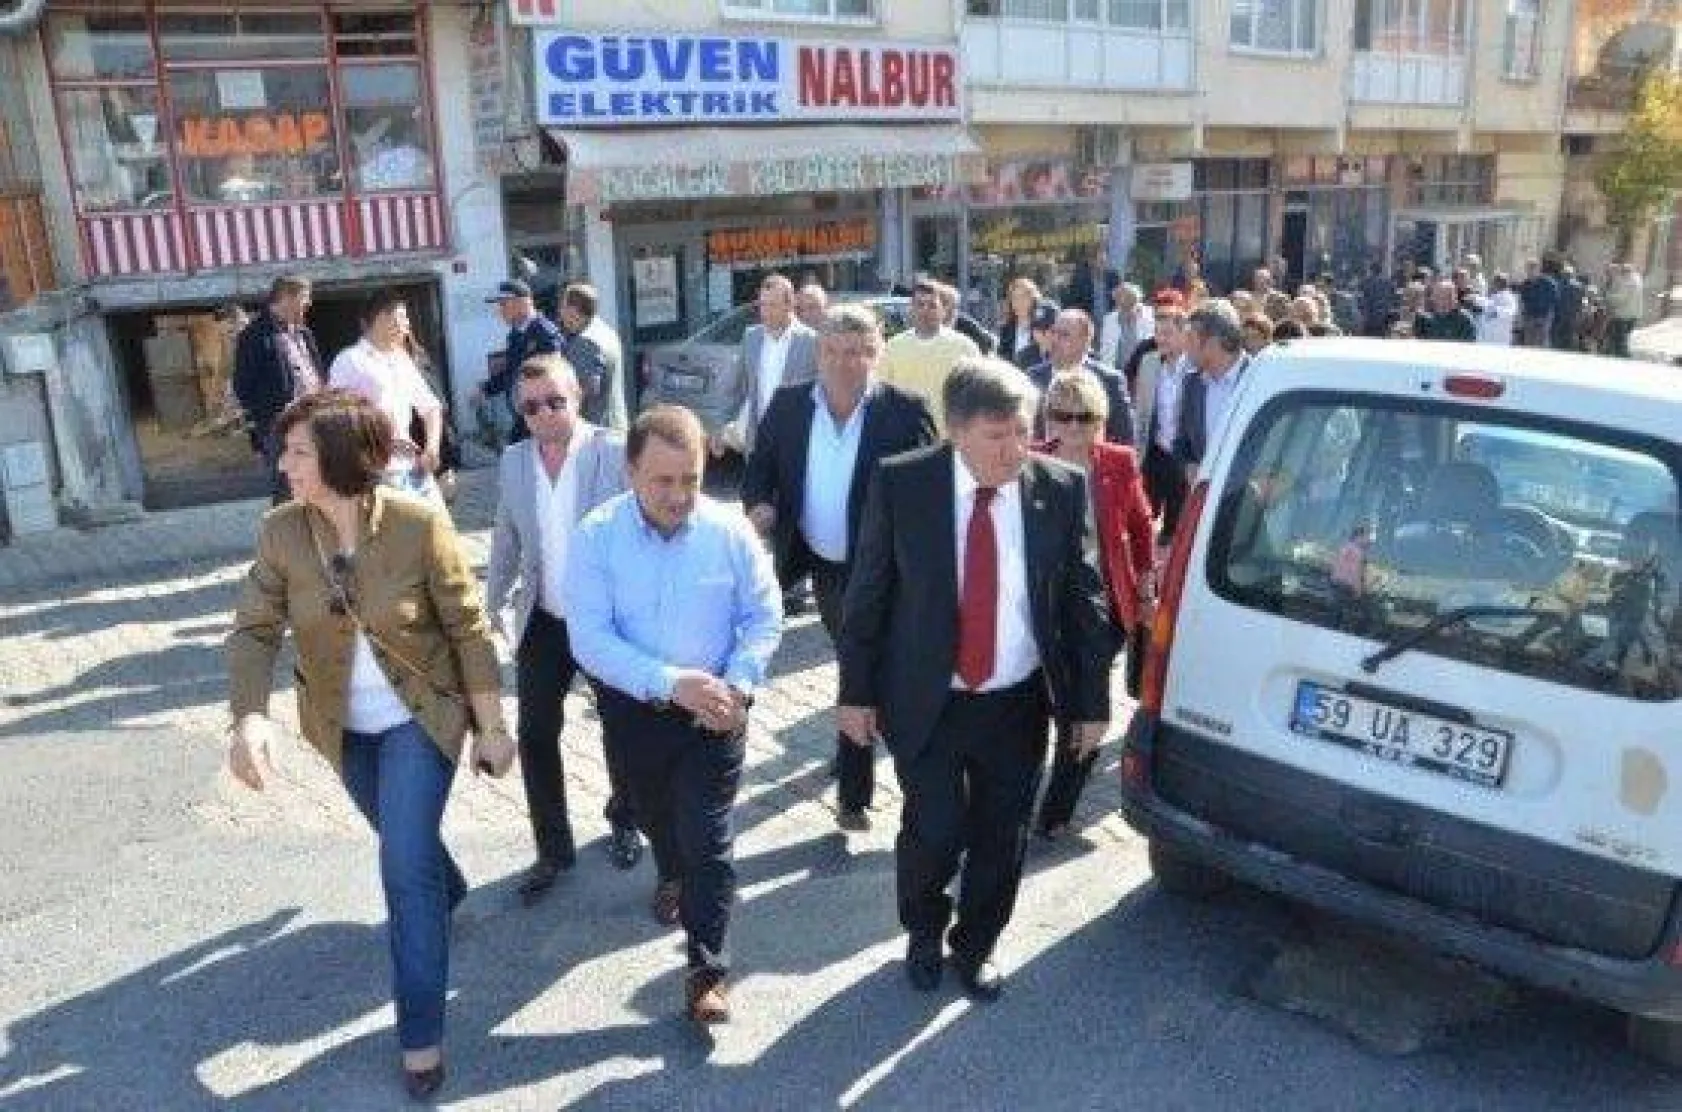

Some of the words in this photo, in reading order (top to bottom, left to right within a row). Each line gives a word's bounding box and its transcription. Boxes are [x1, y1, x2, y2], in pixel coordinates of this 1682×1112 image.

[546, 35, 780, 82] GÜVEN
[797, 48, 956, 107] NALBUR
[1314, 692, 1350, 729] 59
[1372, 706, 1409, 747] UA
[1432, 725, 1499, 768] 329
